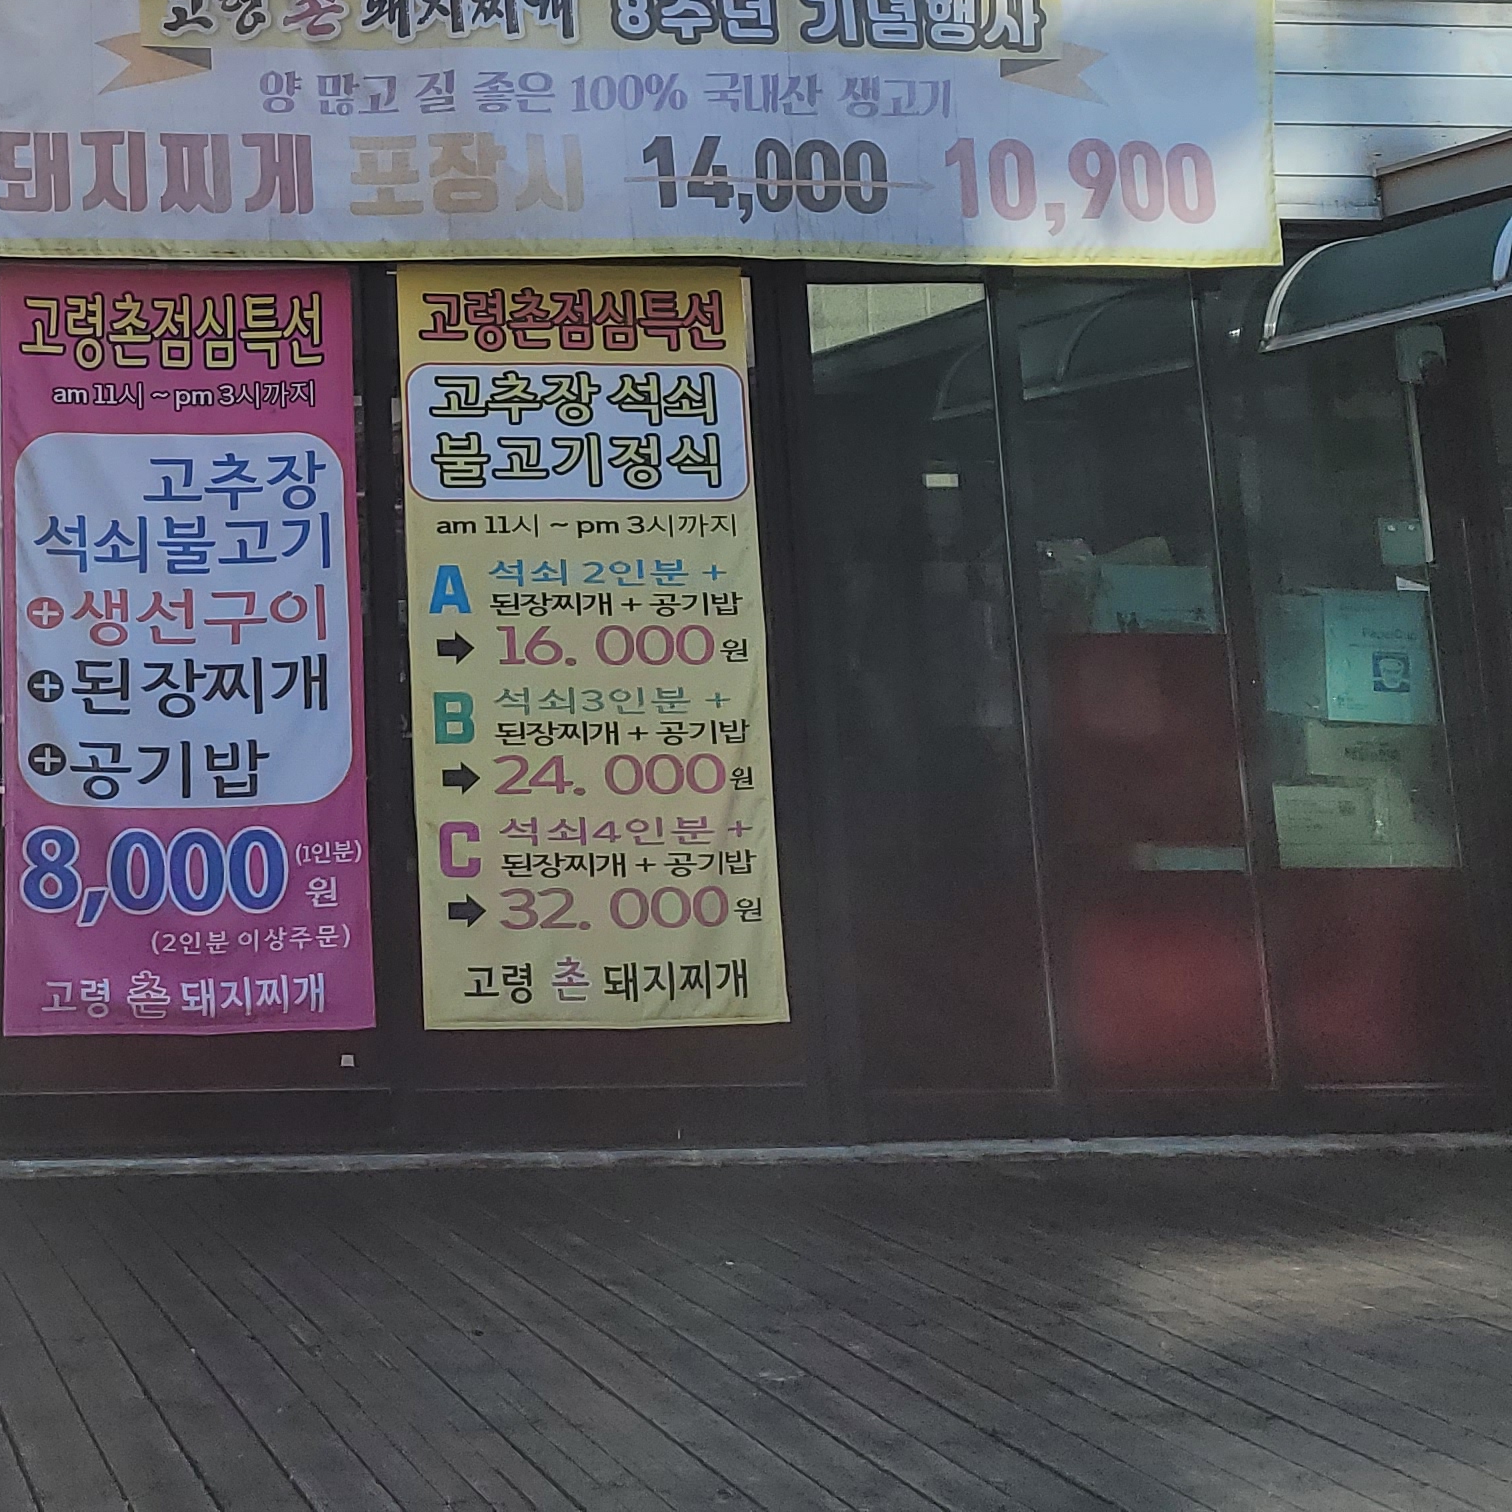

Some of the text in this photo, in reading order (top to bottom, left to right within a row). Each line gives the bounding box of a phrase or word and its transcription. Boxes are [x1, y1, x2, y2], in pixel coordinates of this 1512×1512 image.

[259, 69, 952, 118] 양 많고 질 좋은 100% 국내산 생고기
[348, 132, 585, 216] 포장시
[643, 135, 888, 224] 14,000
[944, 136, 1215, 236] 10,900
[20, 292, 325, 371] 고령촌점심특선
[419, 287, 726, 352] 고령촌점심특선
[53, 386, 88, 405] am
[93, 381, 144, 410] 11시
[174, 389, 213, 411] pm
[218, 380, 316, 410] 3시까지
[429, 370, 719, 427] 고추장 석쇠
[143, 450, 326, 511] 고추장
[431, 432, 723, 490] 불고기정식
[33, 511, 331, 575] 석쇠불고기
[436, 518, 477, 534] am
[484, 513, 540, 538] 11시
[577, 517, 620, 538] pm
[626, 513, 737, 538] 3시까지
[429, 564, 472, 614] A
[583, 558, 690, 587] 2인분
[70, 584, 327, 647] 생선구이
[489, 592, 613, 617] 된장찌개
[649, 591, 743, 617] 공기밥
[70, 653, 329, 718] 된장찌개
[433, 691, 476, 745] B
[494, 720, 619, 746] 된장찌개
[655, 719, 750, 746] 공기밥
[69, 739, 270, 800] 공기밥
[19, 825, 340, 927] 8,000 원
[295, 840, 362, 867] (1인분)
[438, 821, 481, 878] C
[501, 852, 626, 878] 된장찌개
[663, 849, 757, 877] 공기밥
[41, 970, 326, 1019] 고령 촌 돼지찌개
[464, 955, 748, 1005] 고령 촌 돼지찌개
